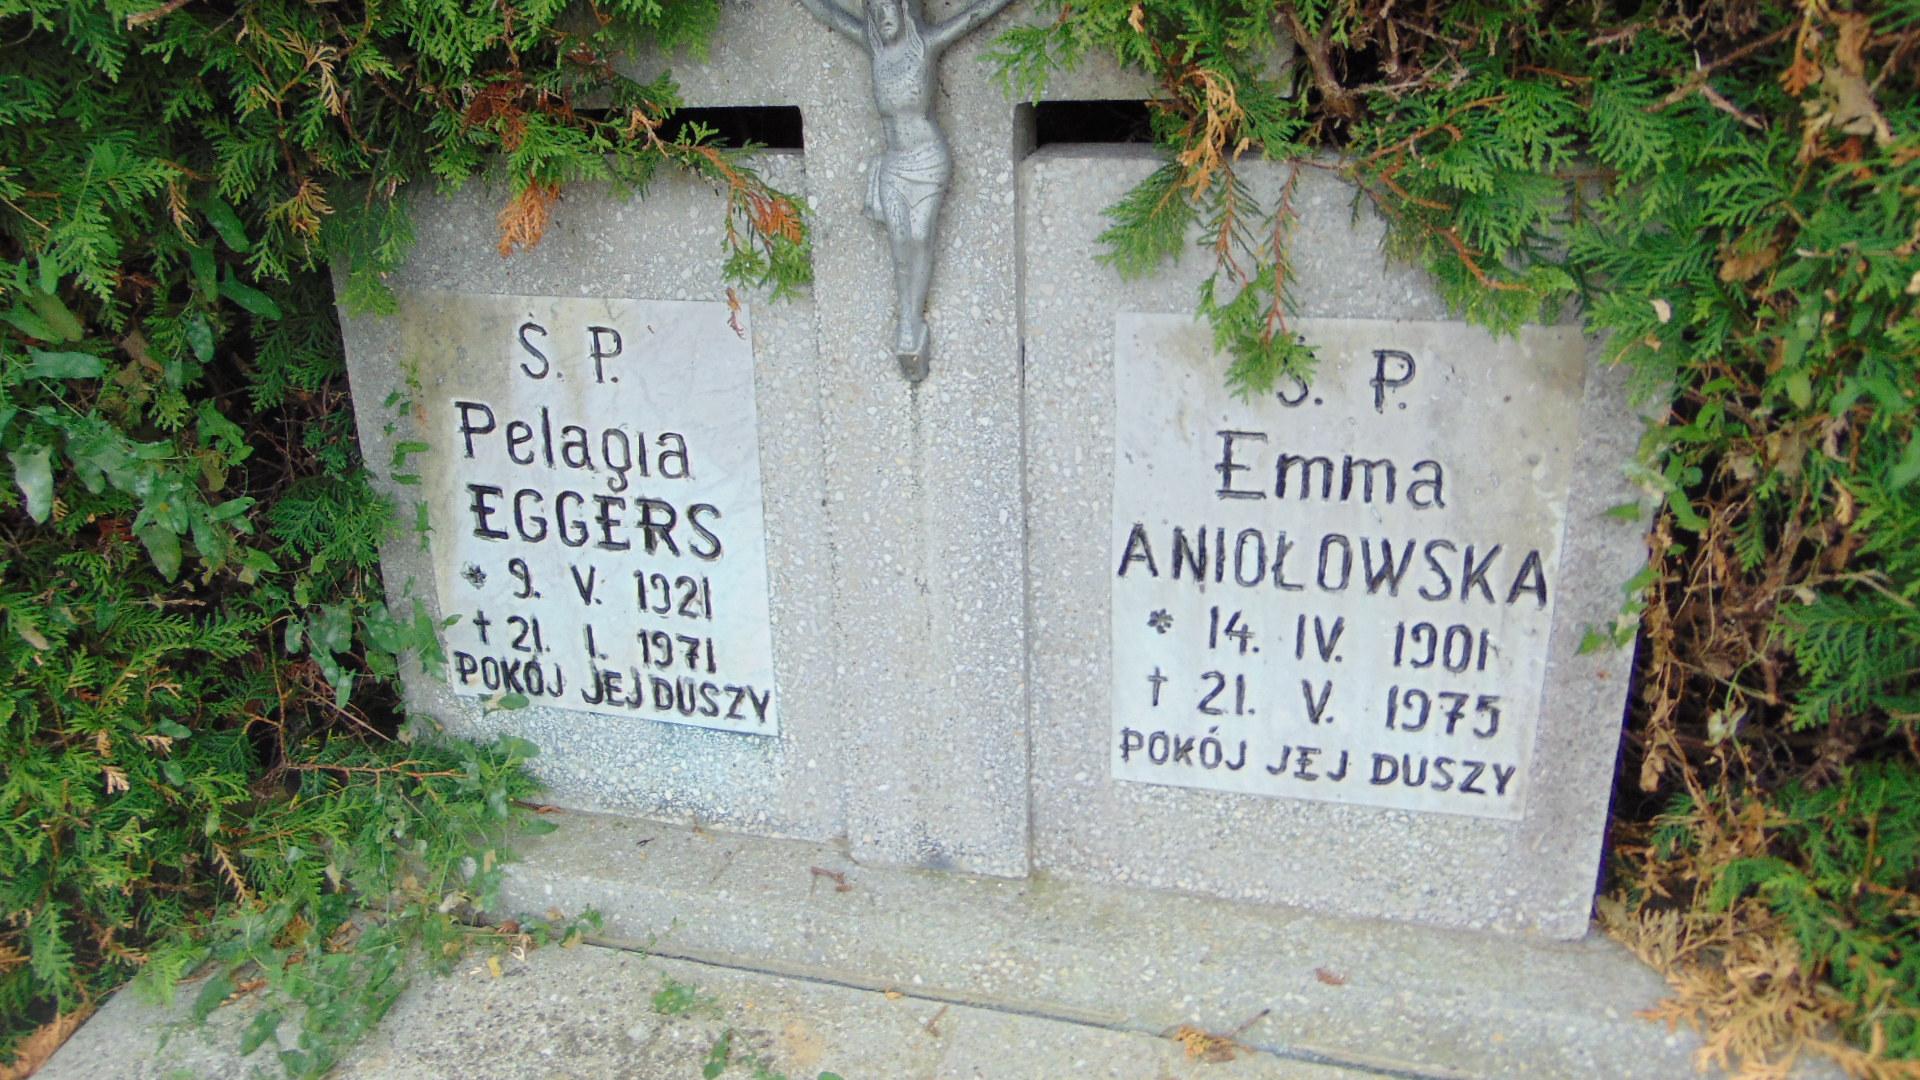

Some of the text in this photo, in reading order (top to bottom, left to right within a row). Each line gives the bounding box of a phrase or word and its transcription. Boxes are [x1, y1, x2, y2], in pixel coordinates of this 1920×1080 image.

[586, 326, 623, 383] P.
[1370, 349, 1416, 414] P.
[454, 401, 695, 492] Pelagia
[1214, 430, 1446, 510] Emma
[467, 484, 724, 562] EGGERS
[508, 557, 713, 621] 9. V. 1921
[1117, 523, 1548, 610] ANIOŁOWSKA
[507, 615, 551, 653] 21.
[636, 628, 717, 675] 1971
[1209, 606, 1490, 673] 14. IV. 1901
[581, 659, 644, 710] JEJ
[650, 675, 772, 724] DUSZY
[1197, 671, 1502, 739] 21. V. 1975
[1120, 726, 1516, 797] POKÓJ JEJ DUSZY
